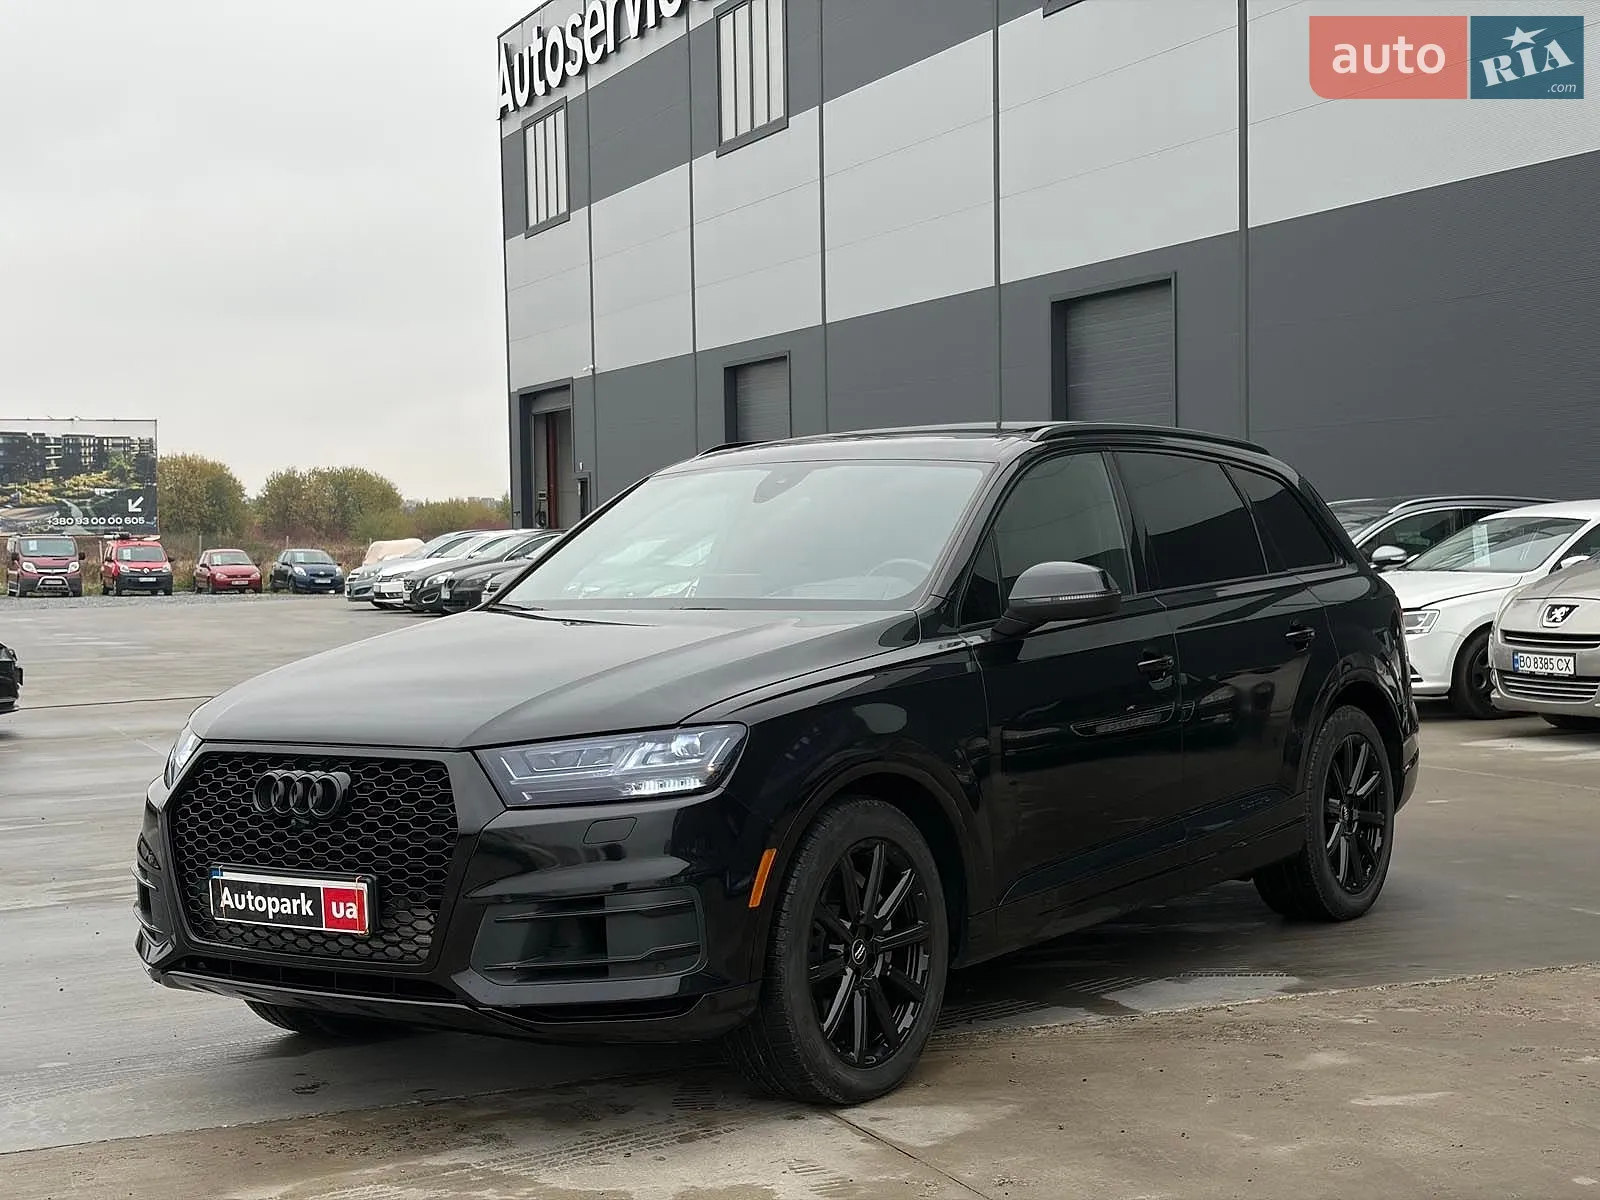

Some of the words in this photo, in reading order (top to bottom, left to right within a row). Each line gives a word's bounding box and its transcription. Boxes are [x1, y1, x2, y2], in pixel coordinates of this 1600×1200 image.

[497, 0, 699, 120] Autoserv
[47, 517, 74, 526] +380
[76, 517, 89, 525] 93
[91, 517, 106, 525] 00
[107, 517, 122, 525] 00
[124, 516, 145, 525] 605
[1519, 655, 1532, 669] BO
[1533, 656, 1555, 671] 8385
[1556, 658, 1571, 672] CX
[220, 887, 314, 919] Autopark
[331, 901, 358, 919] ua
